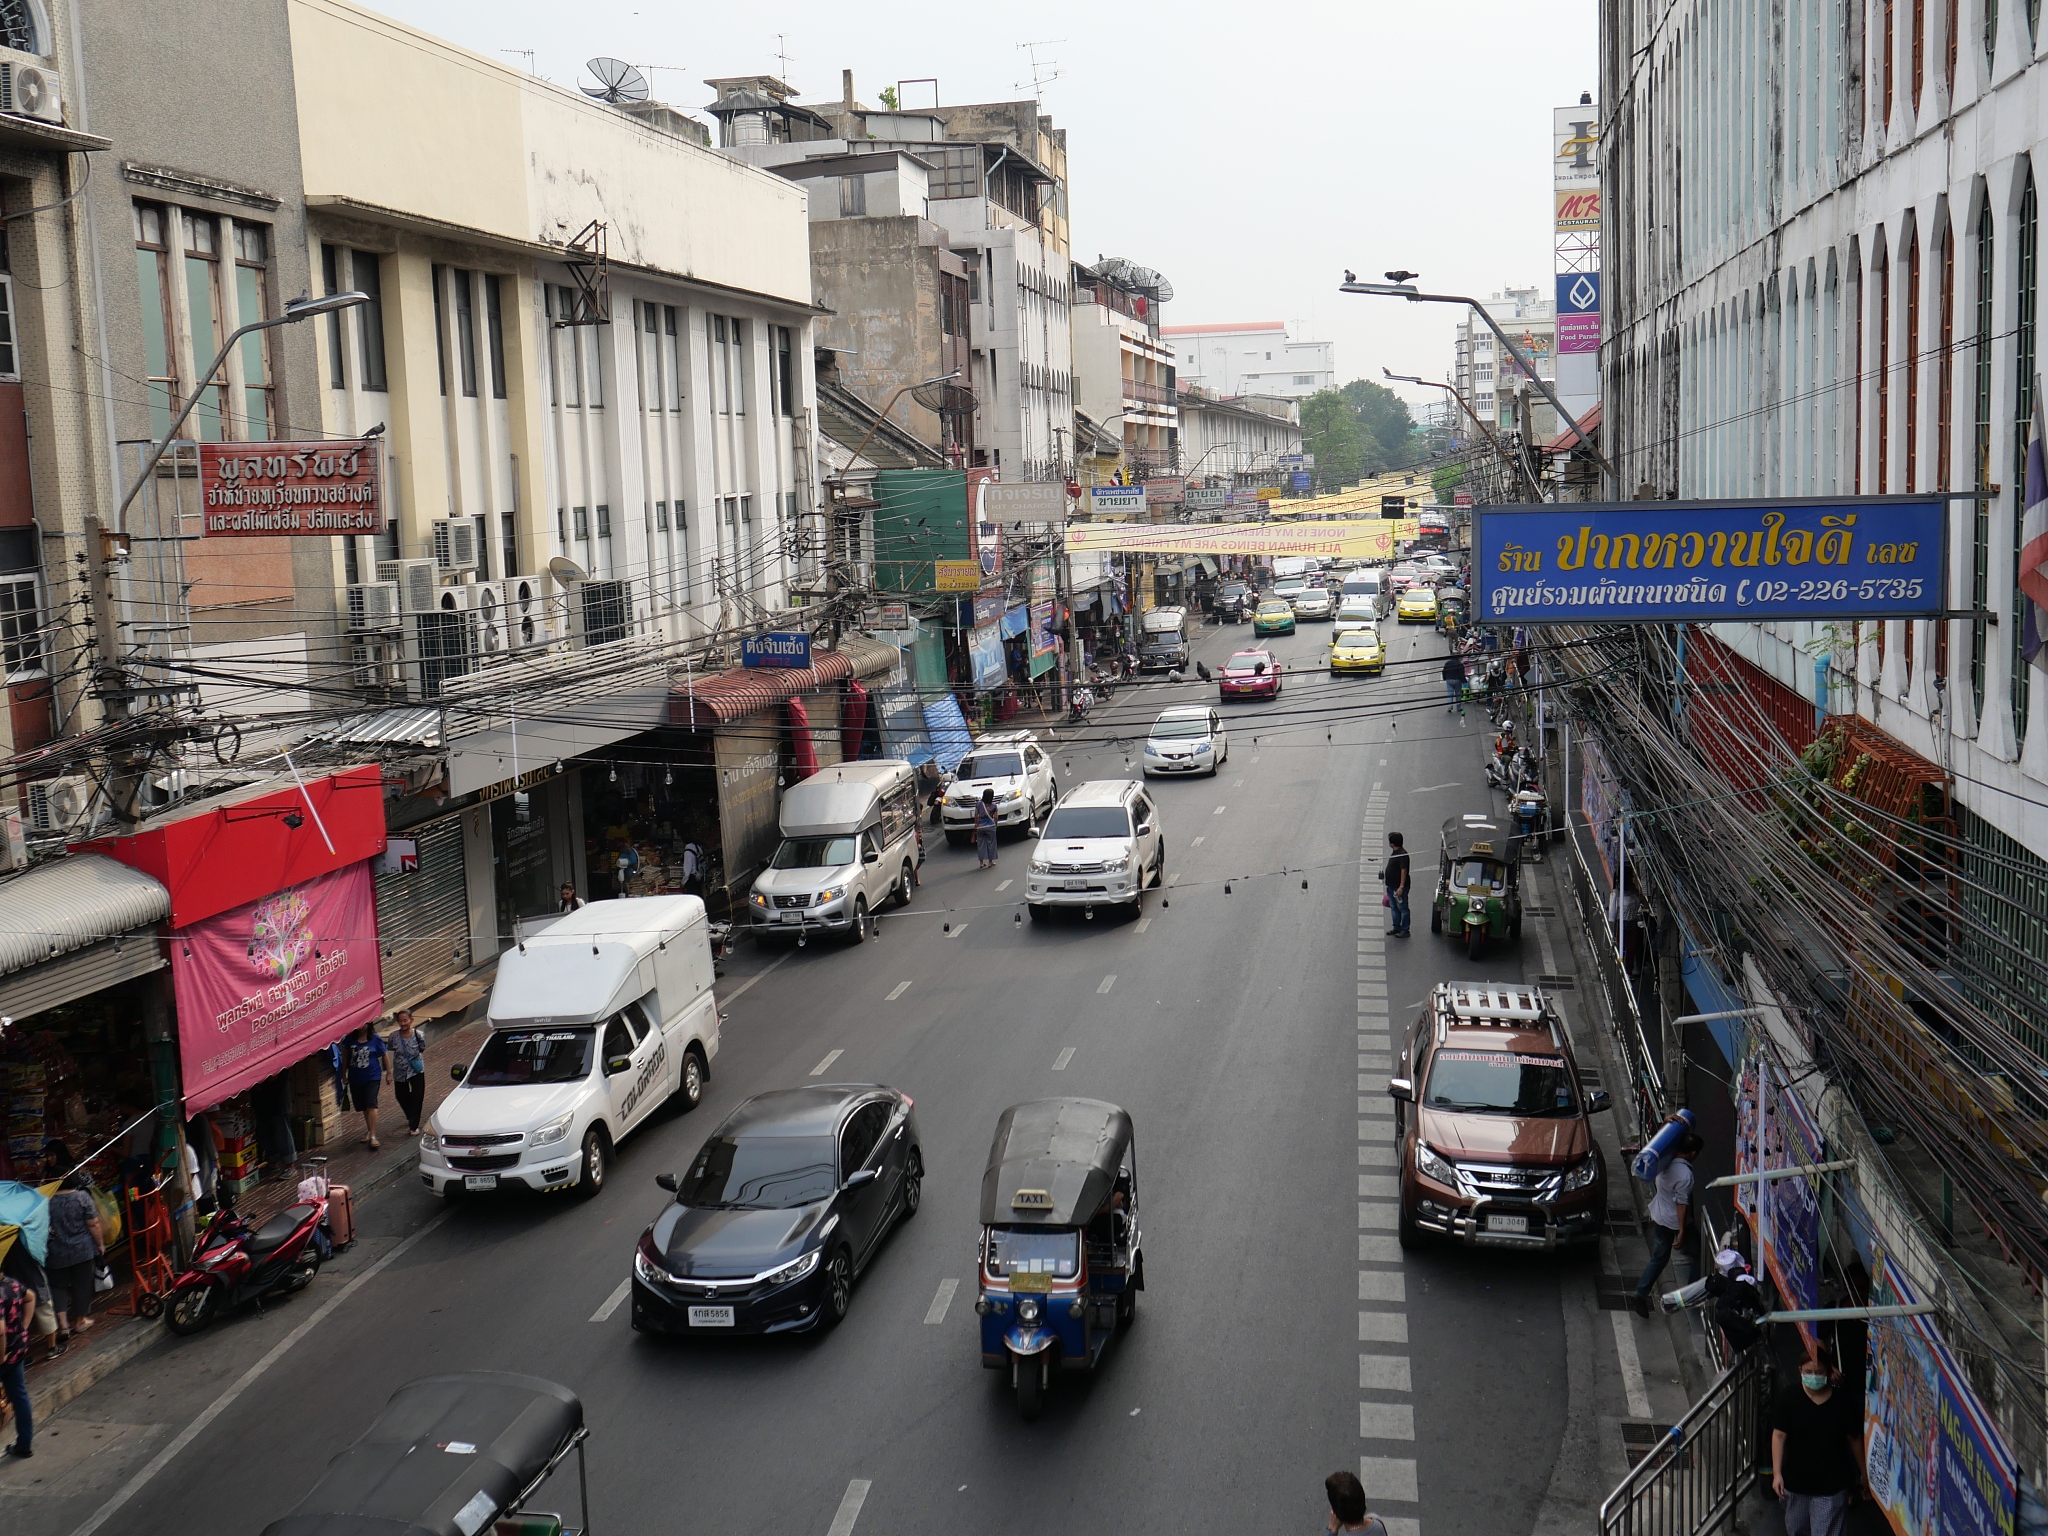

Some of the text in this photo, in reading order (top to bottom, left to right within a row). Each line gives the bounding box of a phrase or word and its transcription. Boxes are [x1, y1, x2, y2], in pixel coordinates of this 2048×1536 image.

[1557, 193, 1600, 219] MK
[1560, 333, 1576, 341] Food
[217, 445, 367, 489] พูลทรัพย์
[208, 479, 373, 511] จำหน่ายทุเรียนกวนอย่างดี
[991, 484, 1061, 503] กิจเจริญ
[1097, 497, 1138, 506] ขายยา
[1187, 490, 1223, 498] ขายยา
[209, 504, 373, 531] และผลไม้แช่อิ่ม ปลีกและส่ง
[1498, 541, 1541, 572] ร้าน
[1557, 511, 1858, 570] ปากหวานใจดี
[1491, 577, 1924, 614] ศูนย์รวมผ้านานาชนิด 02-226-5735
[746, 635, 804, 655] ตังจิบเซ้ง
[785, 657, 791, 666] 2
[304, 981, 329, 1005] SHOP
[216, 989, 265, 1033] พูลทรัพย์
[617, 1042, 666, 1121] COLORADO
[1491, 1174, 1525, 1183] ISUZU
[1020, 1194, 1043, 1204] TAXI
[1506, 1217, 1525, 1226] 3048
[710, 1309, 729, 1318] 5856
[1940, 1391, 1975, 1479] NAGAR
[1975, 1452, 2014, 1536] KIRTAN
[1945, 1446, 1986, 1536] BANGKOK
